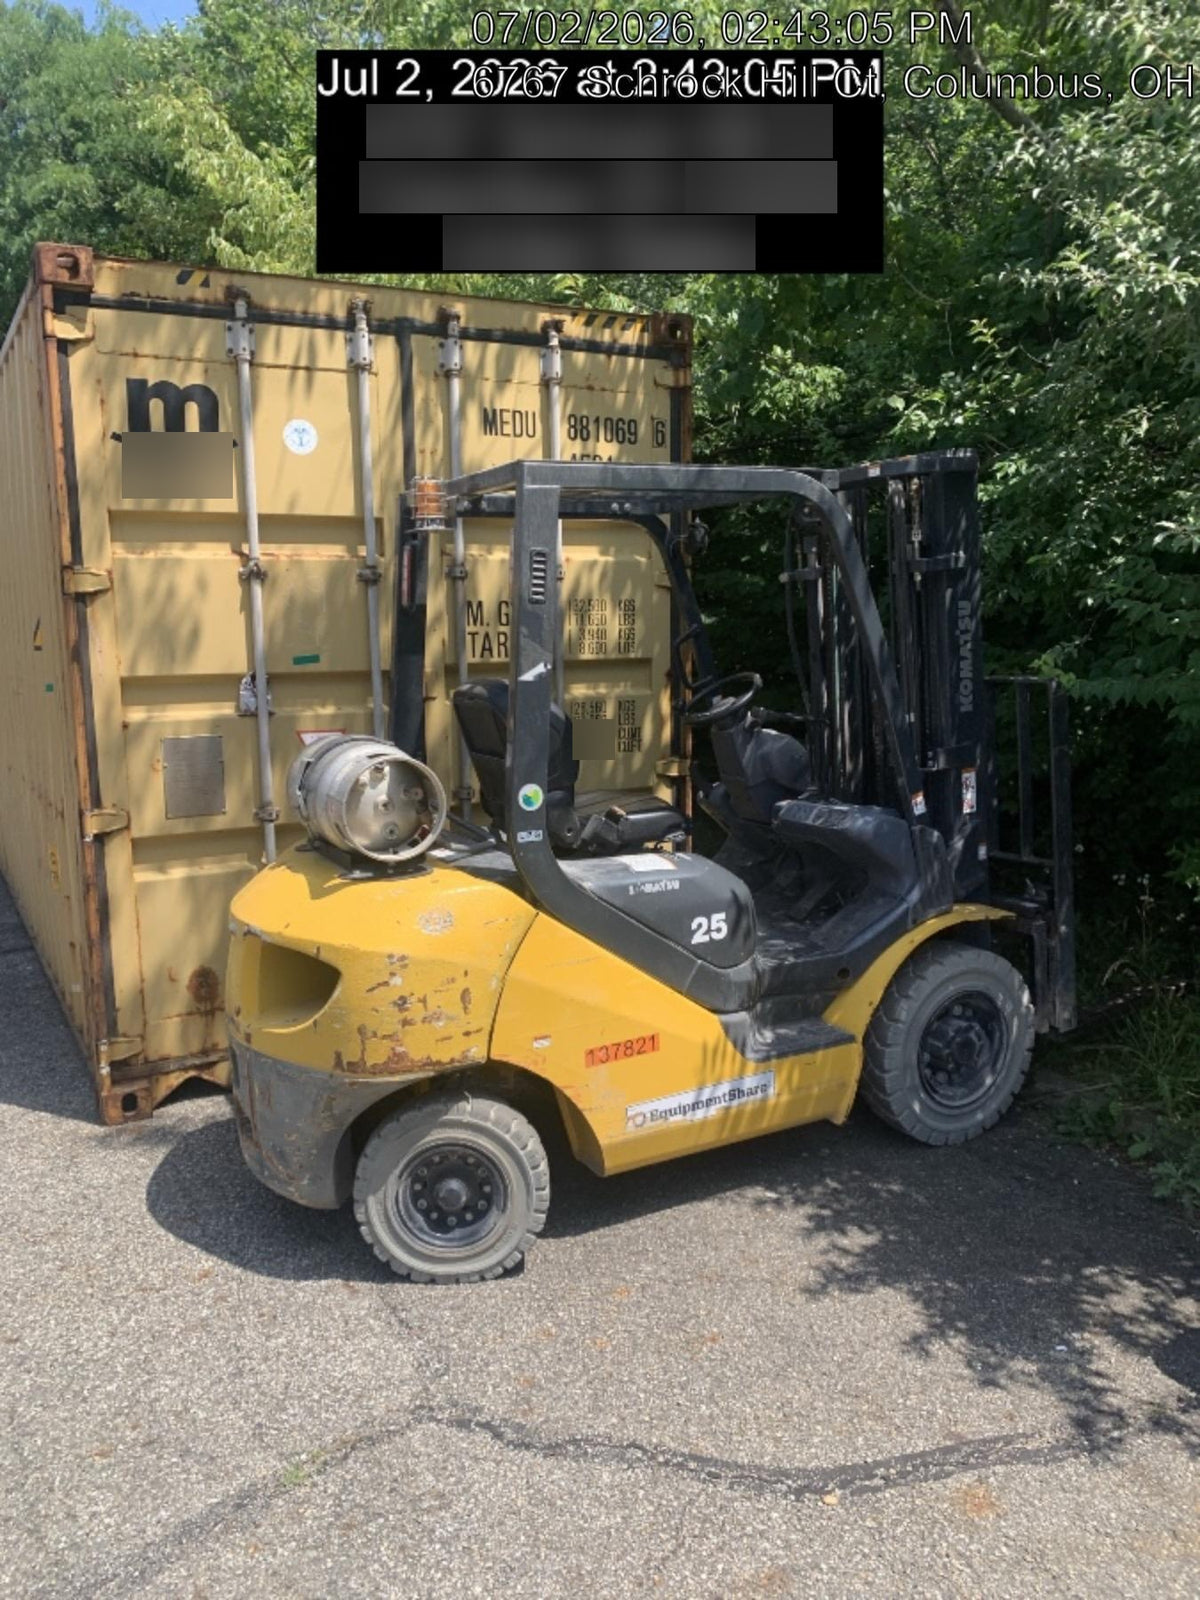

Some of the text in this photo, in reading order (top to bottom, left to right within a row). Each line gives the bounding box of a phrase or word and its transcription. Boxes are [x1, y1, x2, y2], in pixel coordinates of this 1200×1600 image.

[482, 407, 666, 448] MEDU 881069 6
[466, 600, 513, 628] M. G
[617, 599, 636, 613] KGS
[617, 613, 636, 626] LBS
[467, 631, 509, 659] TAR
[617, 627, 636, 641] KGS
[955, 600, 974, 712] KOMATSU
[691, 911, 728, 945] 25
[585, 1033, 658, 1067] 137821
[649, 1083, 769, 1122] EquipmentShare
